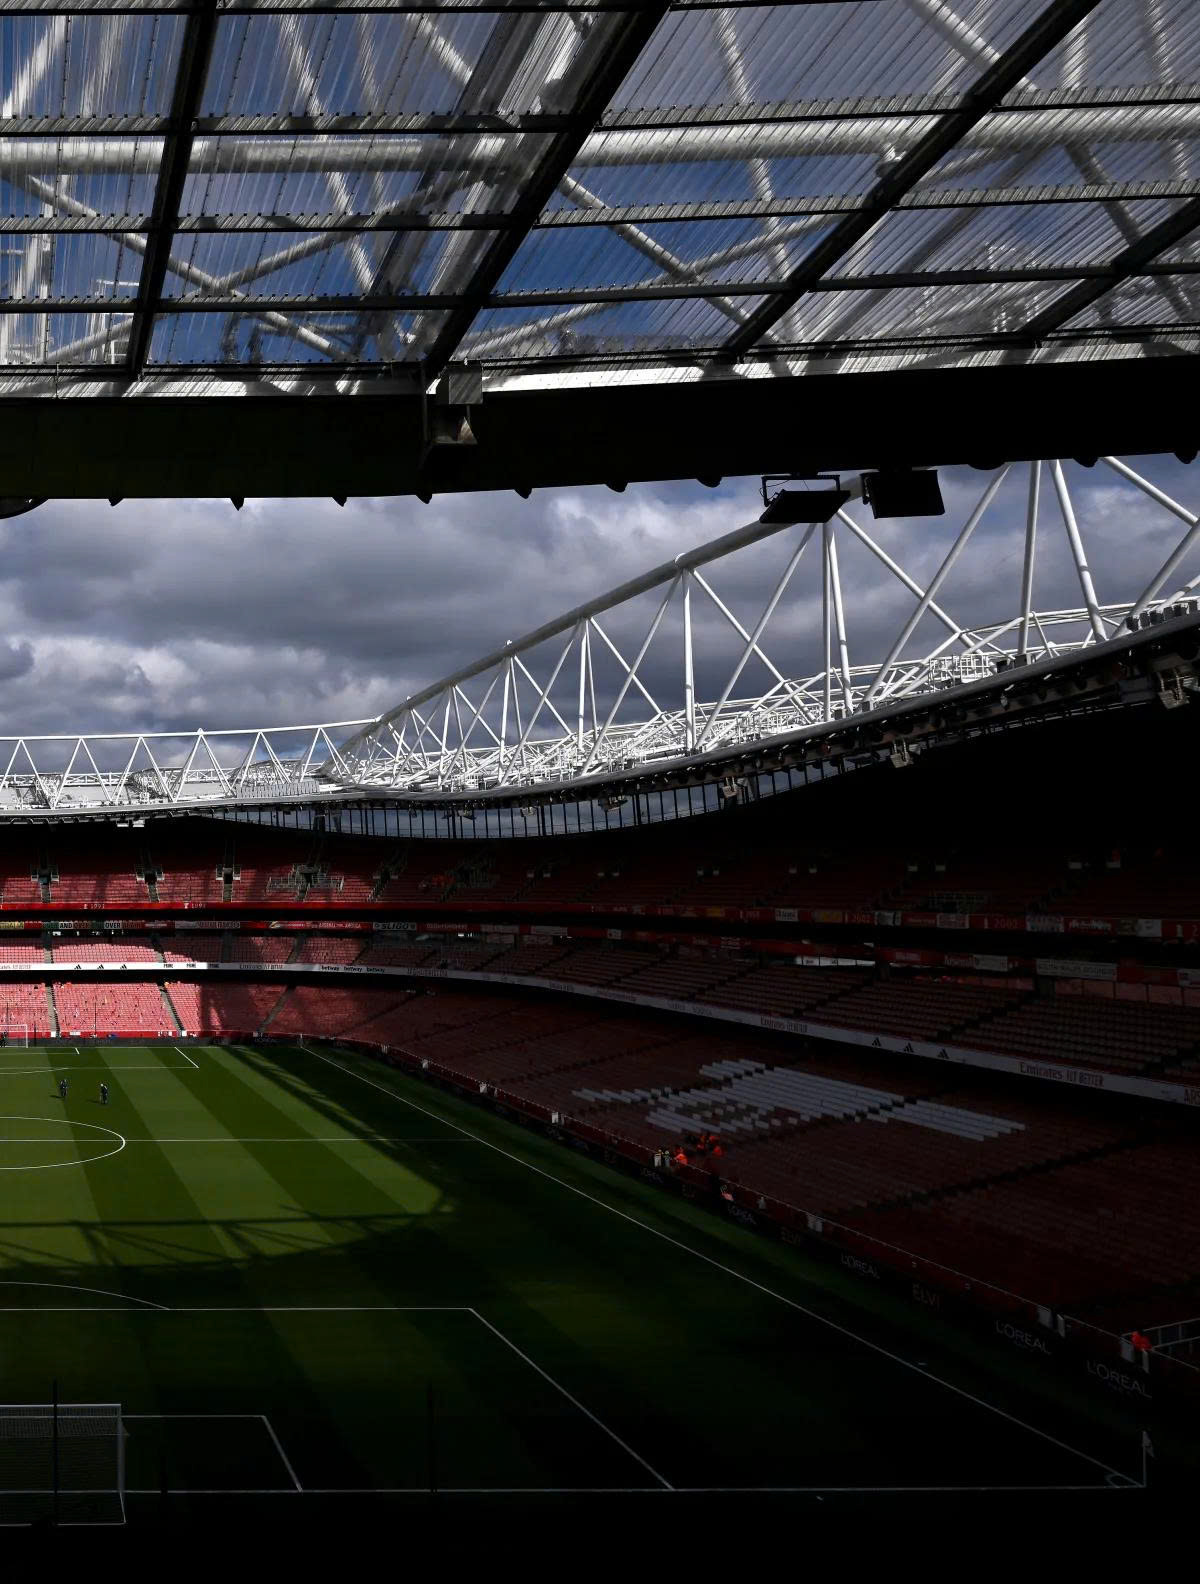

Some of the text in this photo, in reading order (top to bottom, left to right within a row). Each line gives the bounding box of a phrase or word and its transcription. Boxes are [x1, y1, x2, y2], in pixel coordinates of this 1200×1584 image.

[59, 921, 73, 930] AND
[105, 921, 121, 930] OVER
[381, 921, 409, 930] SLIGO
[1019, 1063, 1064, 1080] Emirates
